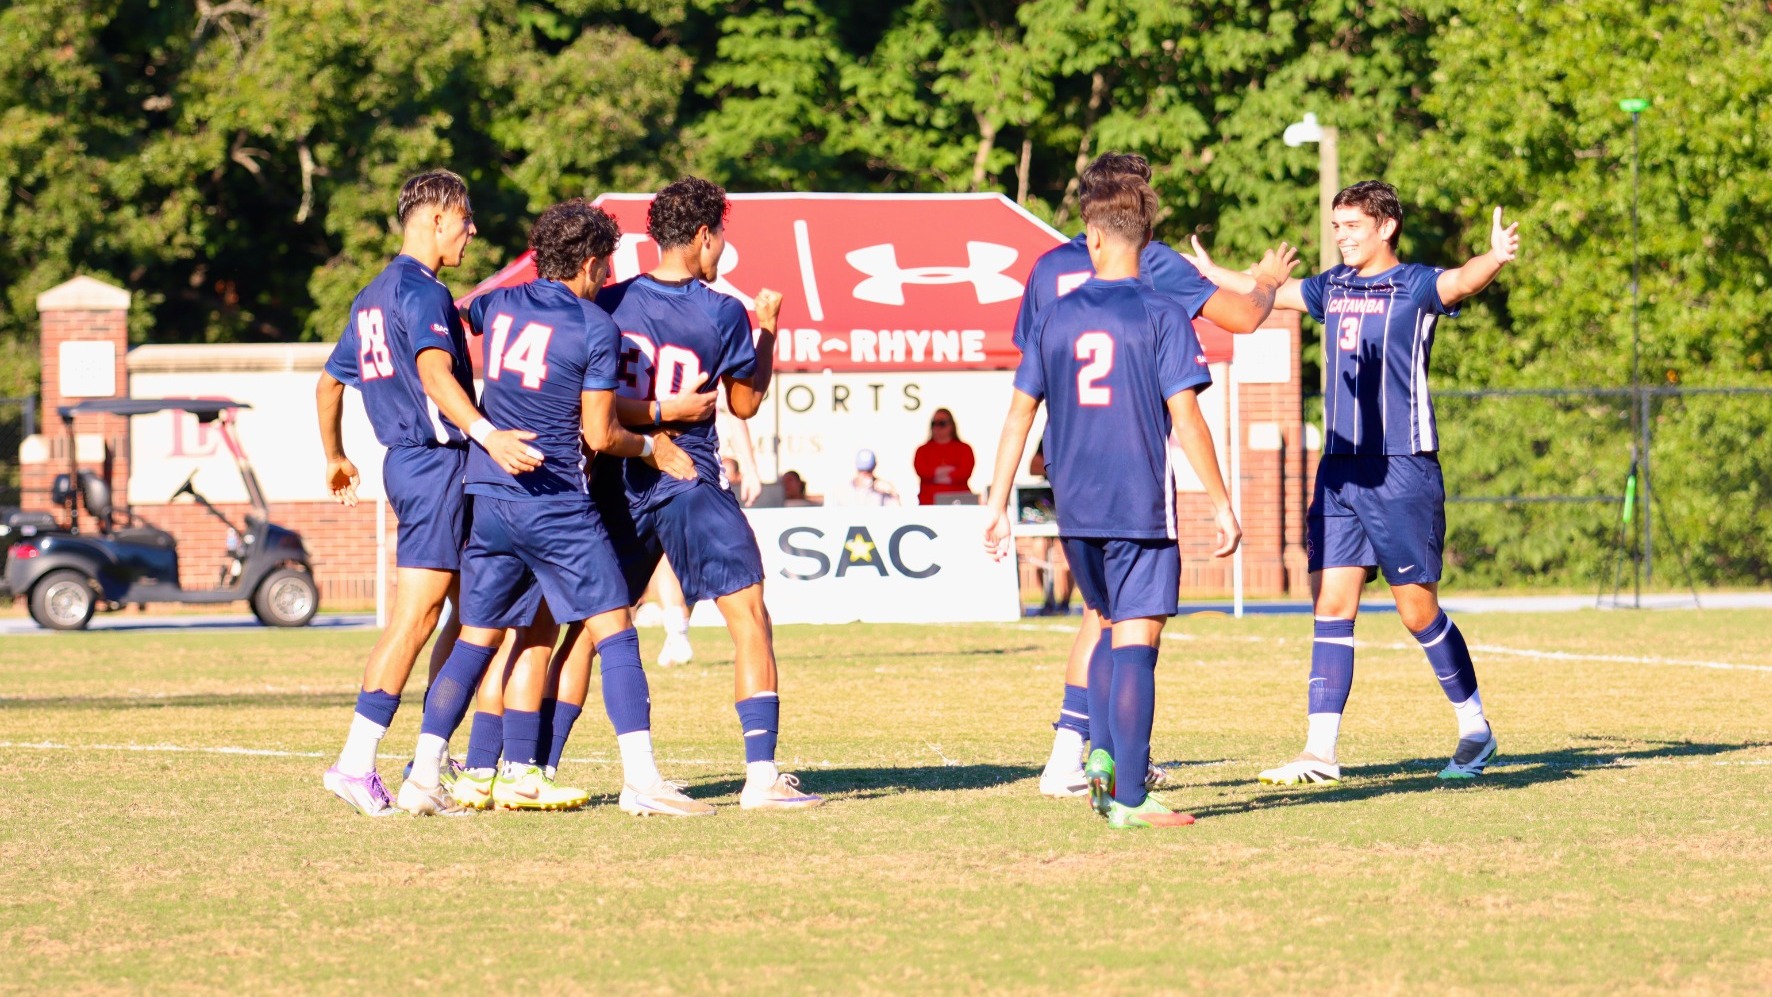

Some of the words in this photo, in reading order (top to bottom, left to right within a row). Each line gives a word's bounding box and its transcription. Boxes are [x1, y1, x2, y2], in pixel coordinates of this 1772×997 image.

[433, 323, 449, 335] SAC
[1328, 298, 1385, 314] CATAWBA
[1340, 316, 1359, 350] 3
[357, 308, 395, 381] 28
[488, 313, 554, 391] 14
[615, 332, 701, 401] 30
[1074, 331, 1114, 406] 2
[763, 383, 921, 413] ORTS
[778, 524, 942, 581] SAC
